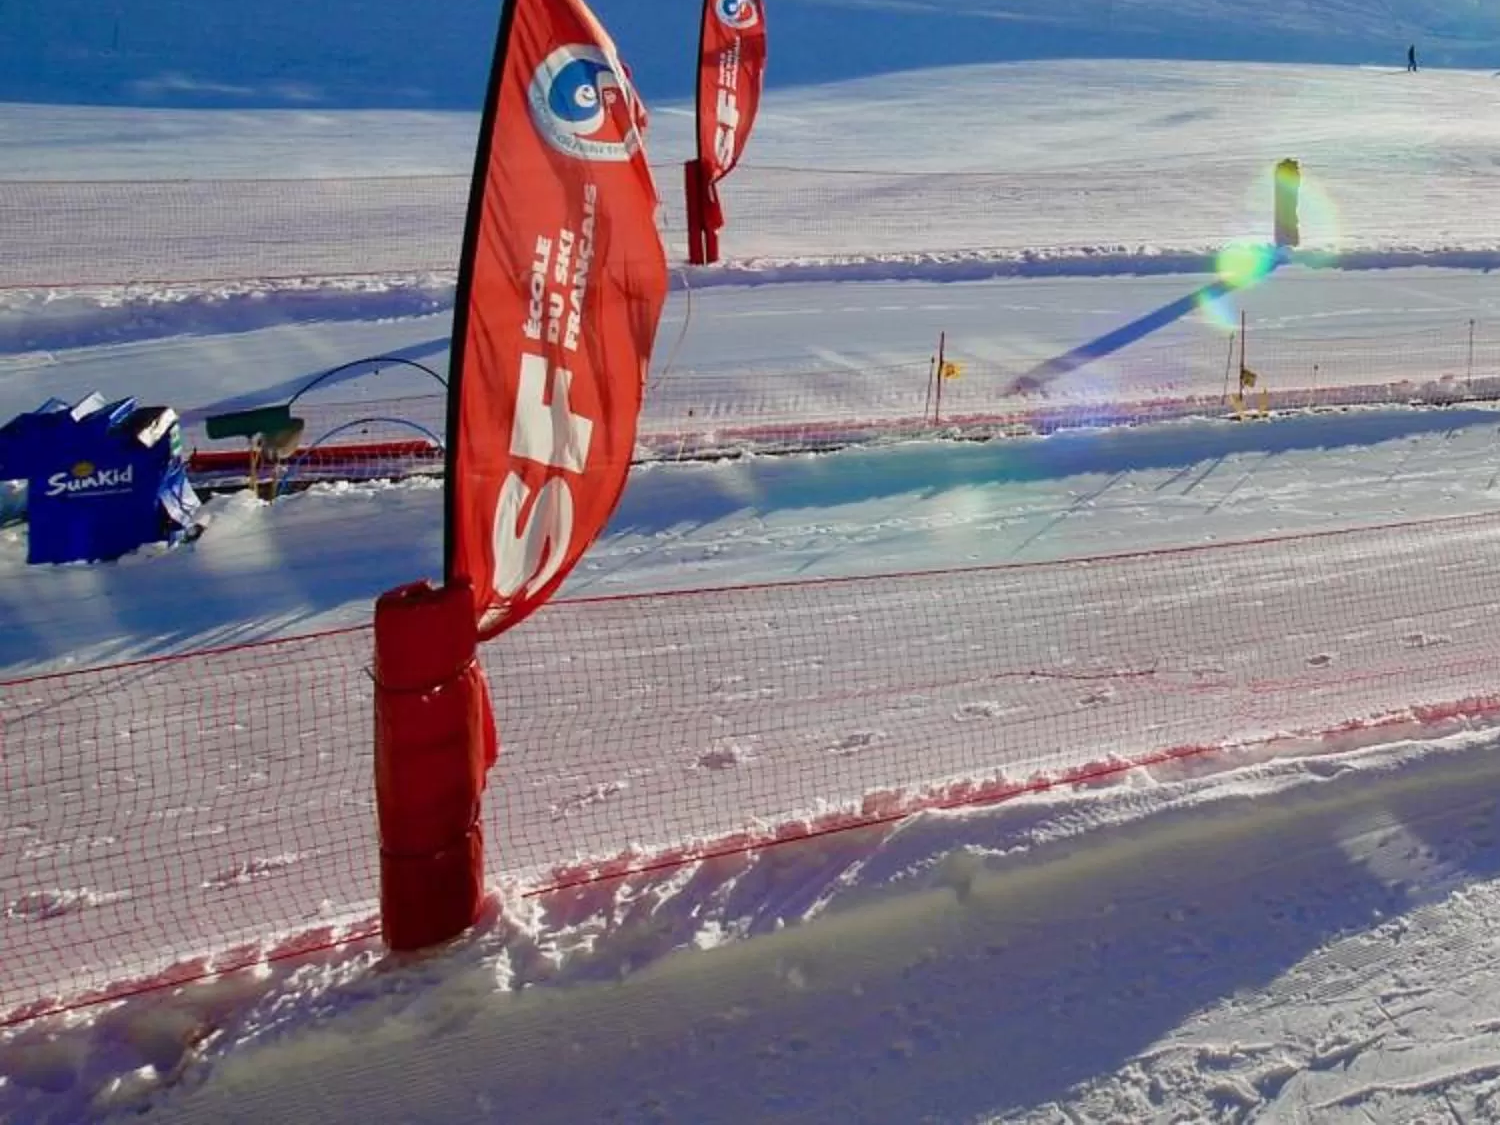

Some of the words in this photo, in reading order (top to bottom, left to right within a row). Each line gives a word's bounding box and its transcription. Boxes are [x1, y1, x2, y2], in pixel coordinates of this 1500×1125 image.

[713, 89, 740, 174] SF
[523, 235, 552, 340] ÉCOLE
[554, 228, 575, 287] SKI
[563, 184, 597, 352] FRANÇAIS
[547, 292, 564, 345] DU
[477, 352, 593, 632] SF
